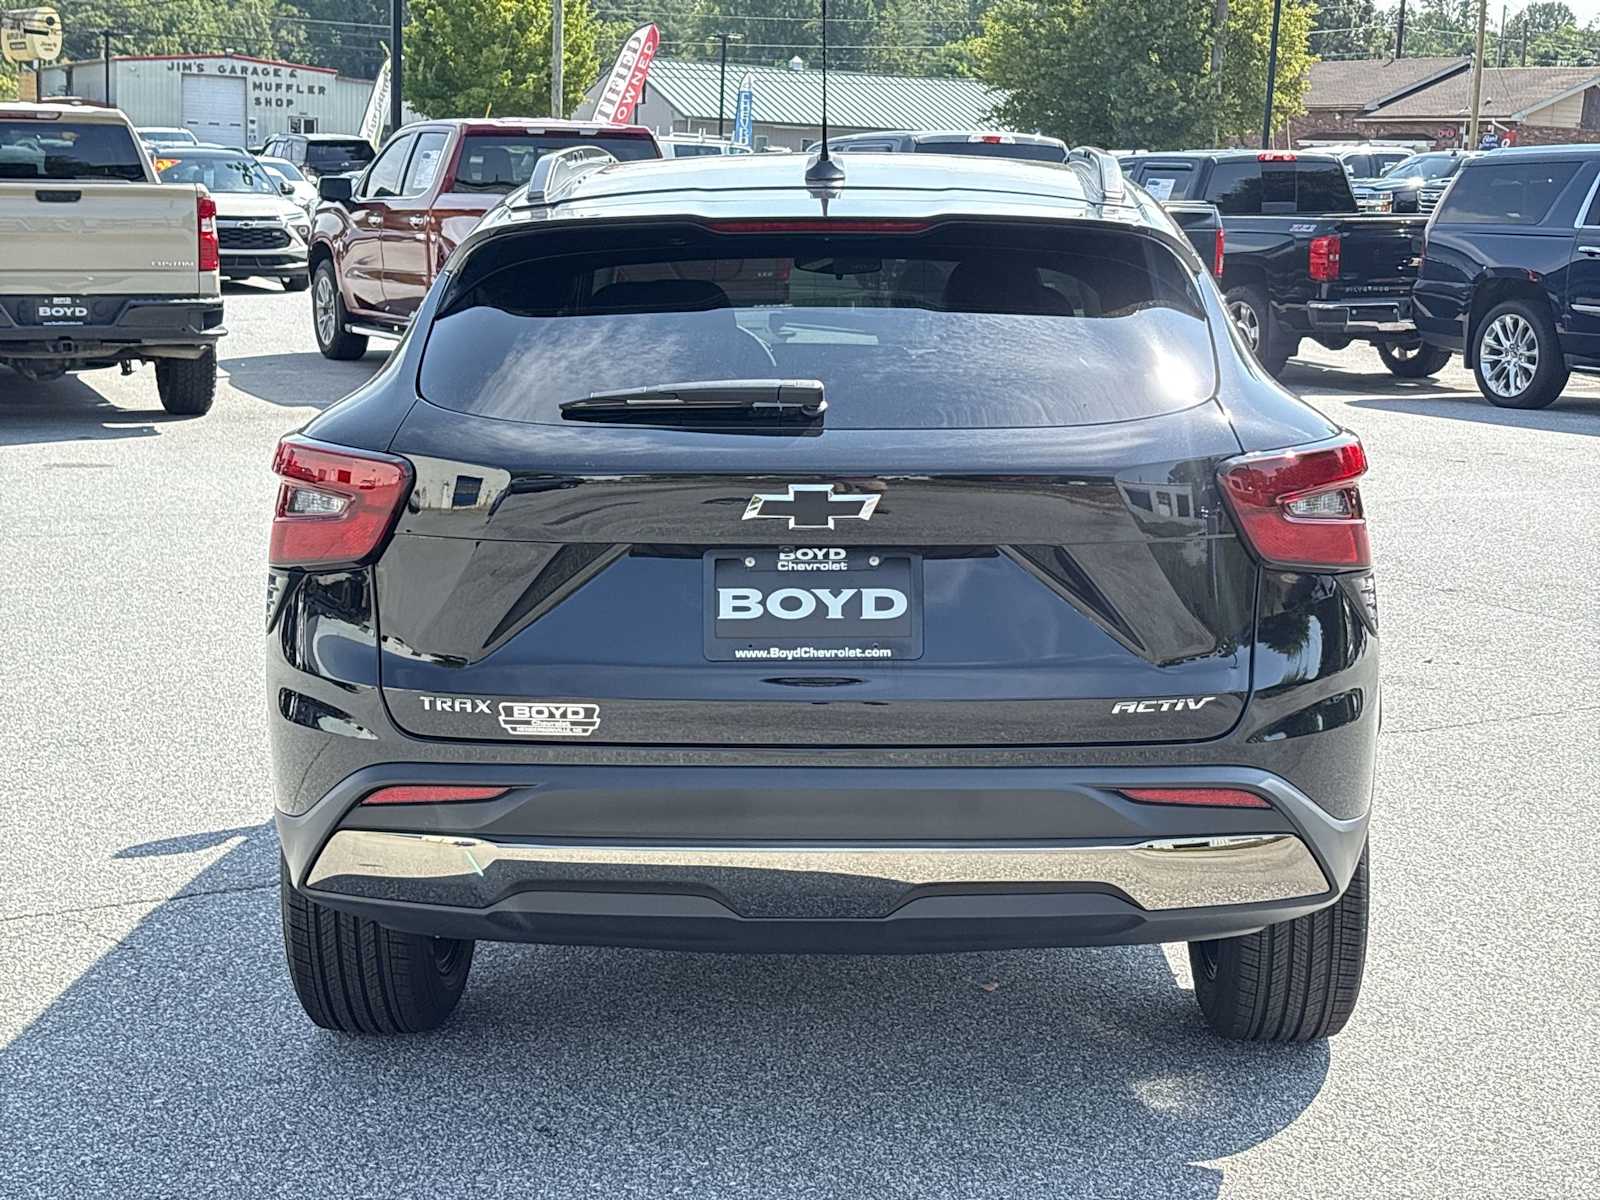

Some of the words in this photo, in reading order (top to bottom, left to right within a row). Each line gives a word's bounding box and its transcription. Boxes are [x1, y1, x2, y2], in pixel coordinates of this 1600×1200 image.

[167, 61, 205, 73] JIM'S
[217, 64, 282, 78] GARAGE
[288, 69, 298, 78] &
[617, 41, 654, 119] OWNED
[252, 81, 327, 96] MUFFLER
[254, 97, 295, 108] SHOP
[39, 306, 88, 317] BOYD
[779, 546, 847, 560] BOYD
[777, 561, 848, 571] Chevrolet
[717, 588, 908, 619] BOYD
[735, 647, 892, 660] www.BoydChevrolet.com
[419, 696, 493, 714] TRAX
[1111, 696, 1217, 714] ACTIV
[513, 706, 585, 719] BOYD
